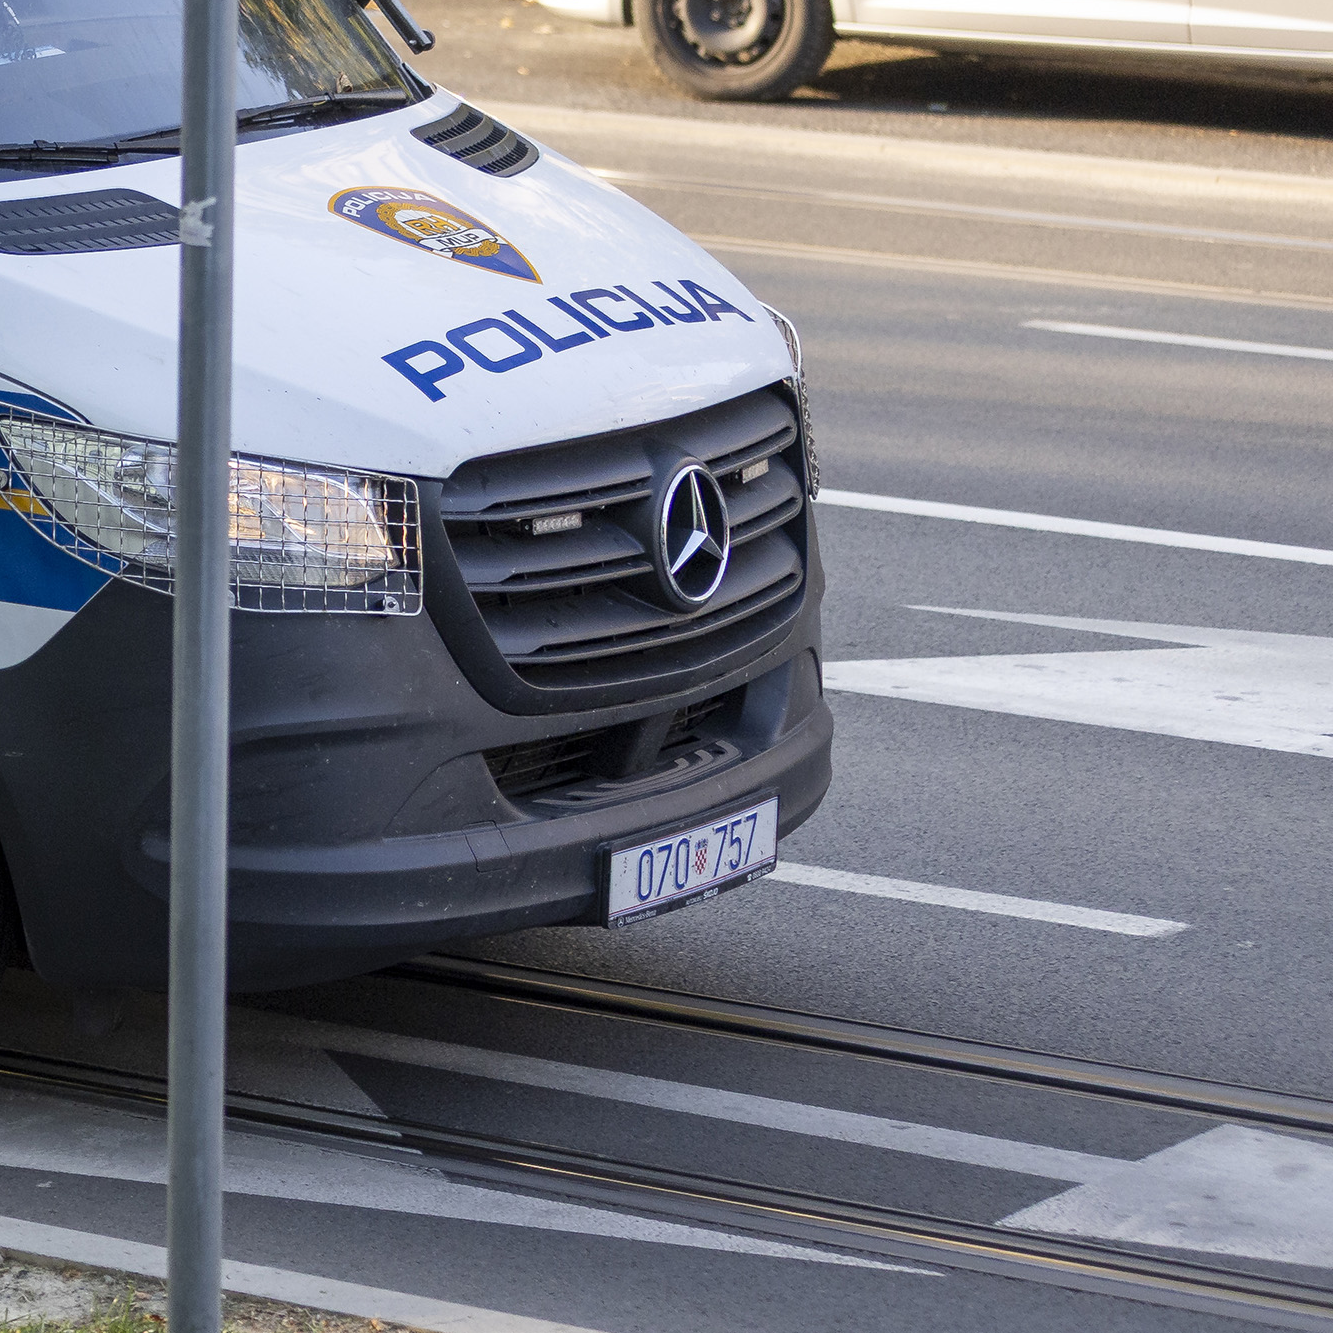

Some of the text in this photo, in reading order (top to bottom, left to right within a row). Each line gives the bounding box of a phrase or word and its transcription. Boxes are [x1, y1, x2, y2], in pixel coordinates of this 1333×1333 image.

[343, 190, 437, 217] POLICIJA
[403, 215, 461, 236] RH
[437, 232, 480, 249] MUP
[380, 279, 755, 403] POLICIJA
[637, 811, 759, 902] 070 757
